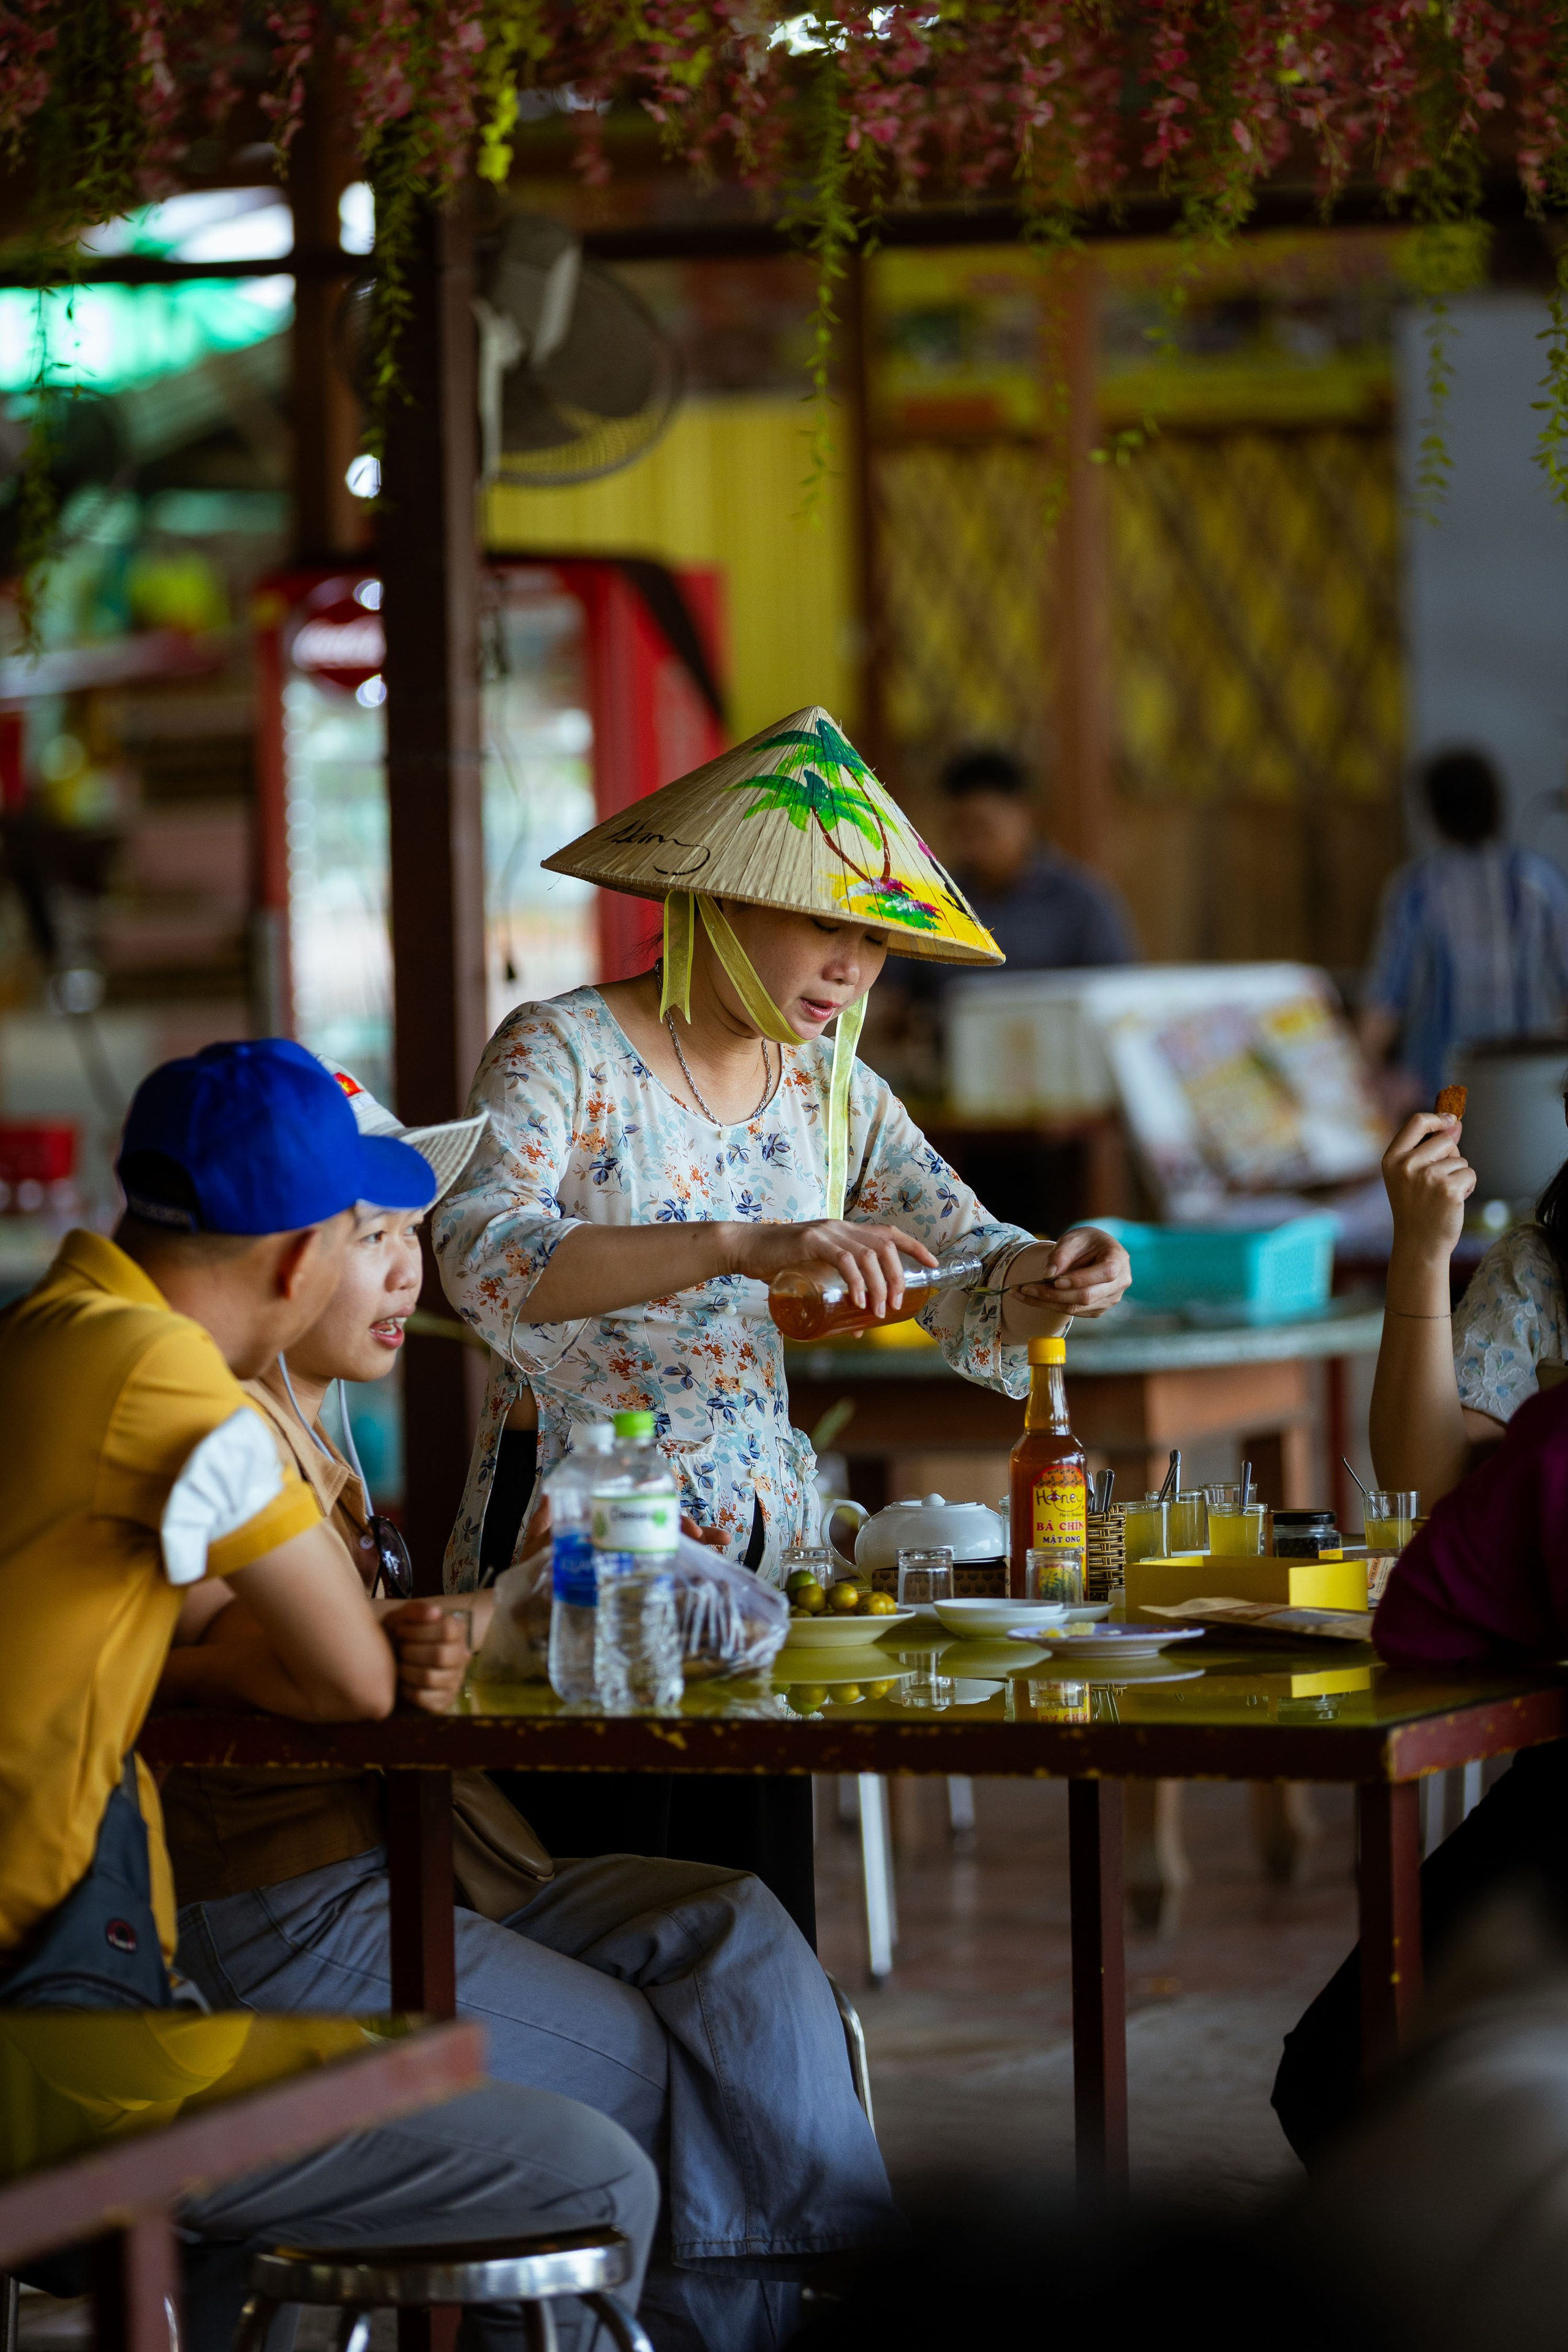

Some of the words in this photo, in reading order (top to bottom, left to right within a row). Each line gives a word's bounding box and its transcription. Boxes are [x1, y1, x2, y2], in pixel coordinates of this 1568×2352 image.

[1036, 1520, 1054, 1531] BÀ
[1058, 1519, 1084, 1531] CHÍN
[1042, 1534, 1063, 1545] MẬT
